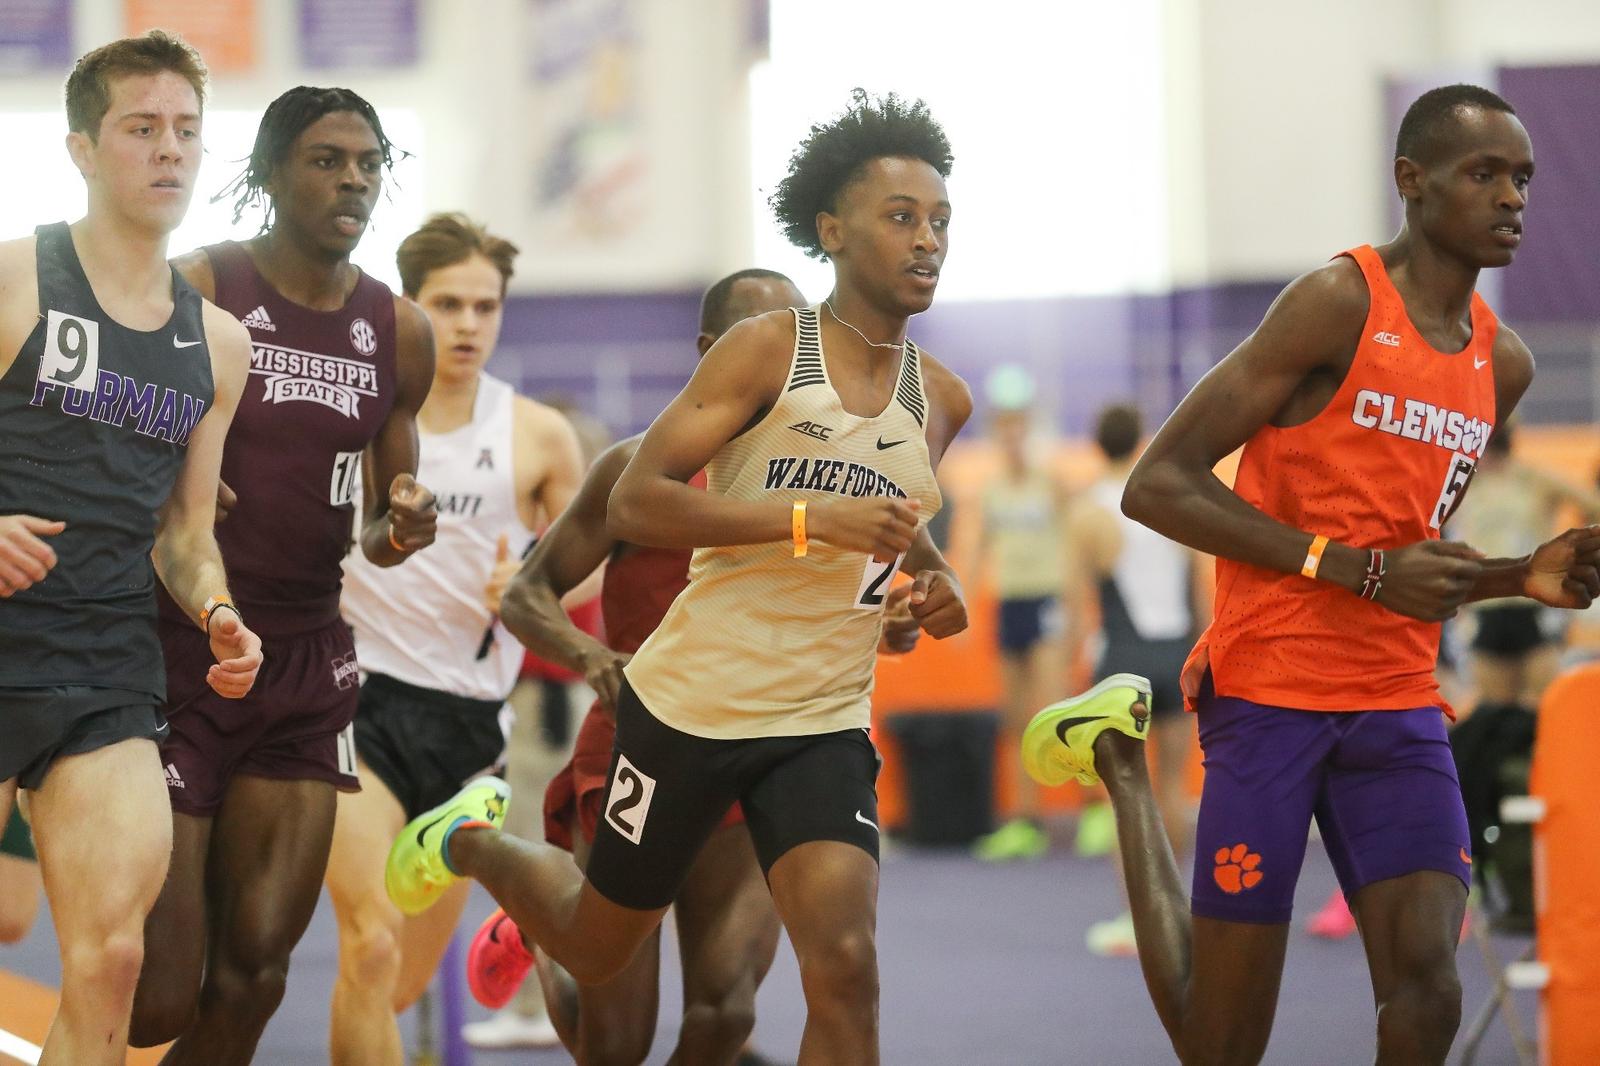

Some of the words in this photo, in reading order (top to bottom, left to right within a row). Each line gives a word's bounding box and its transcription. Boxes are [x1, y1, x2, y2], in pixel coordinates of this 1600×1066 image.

[241, 319, 276, 332] adidas
[352, 318, 376, 354] SEC
[1372, 331, 1400, 347] ACC
[54, 317, 88, 385] 9
[250, 346, 378, 391] MISSISSIPPI
[282, 382, 344, 409] STATE
[789, 420, 834, 442] ACC
[764, 457, 845, 491] WAKE
[608, 766, 644, 837] 2
